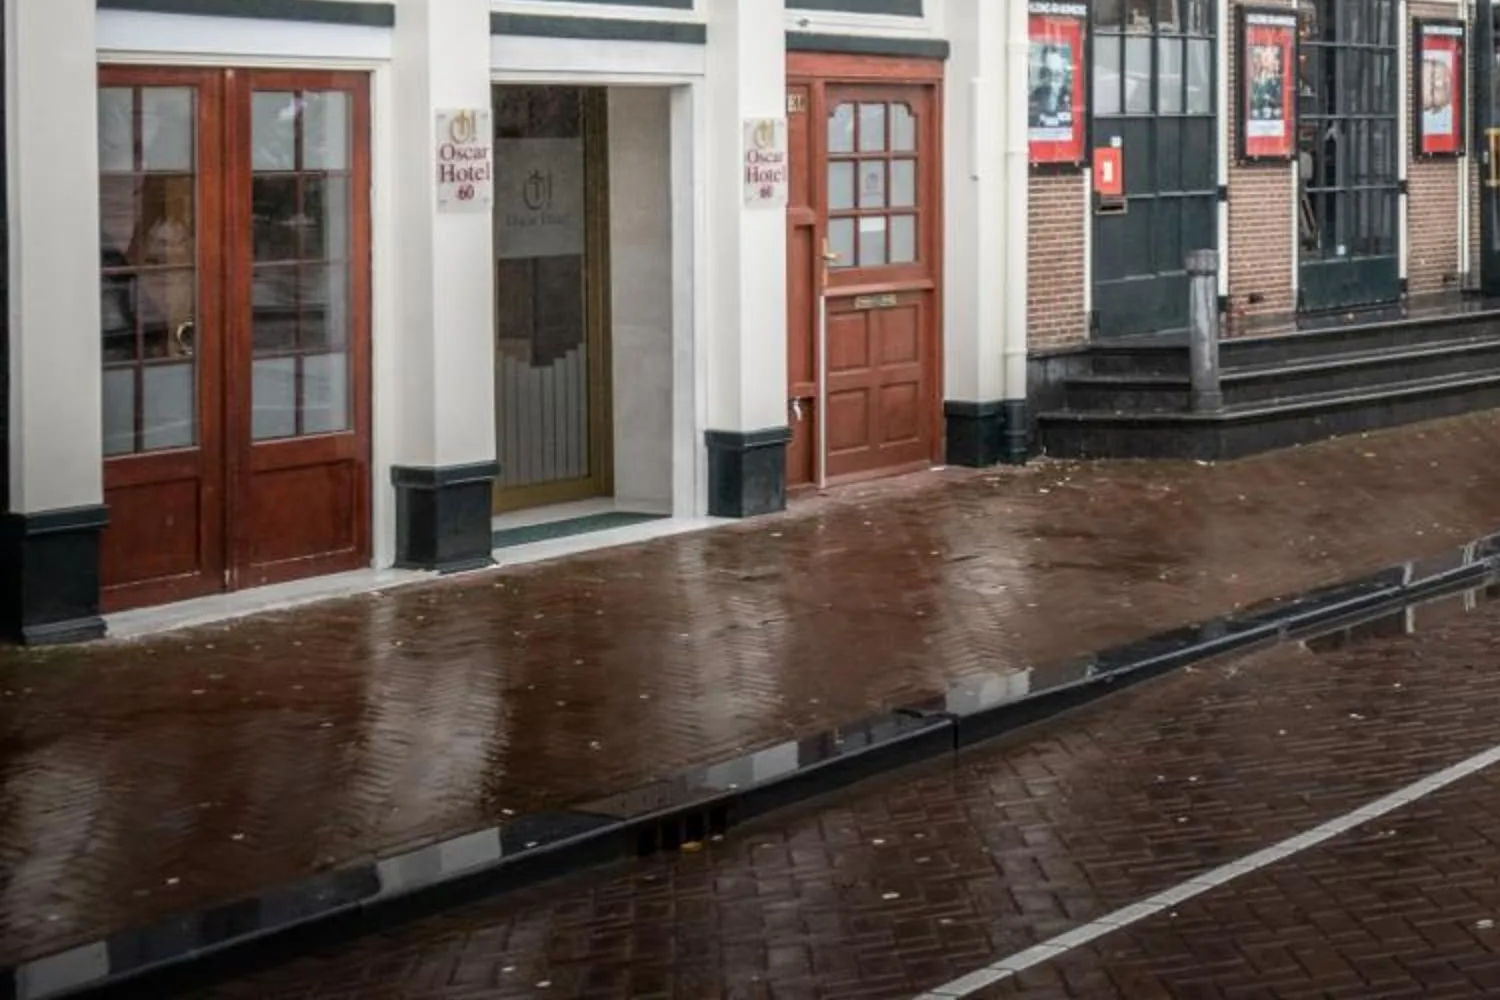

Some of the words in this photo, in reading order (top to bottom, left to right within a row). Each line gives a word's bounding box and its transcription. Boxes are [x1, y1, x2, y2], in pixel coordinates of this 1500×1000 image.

[439, 143, 488, 161] Oscar
[747, 149, 783, 164] Oscar
[438, 162, 491, 184] Hotel
[746, 164, 786, 185] Hotel
